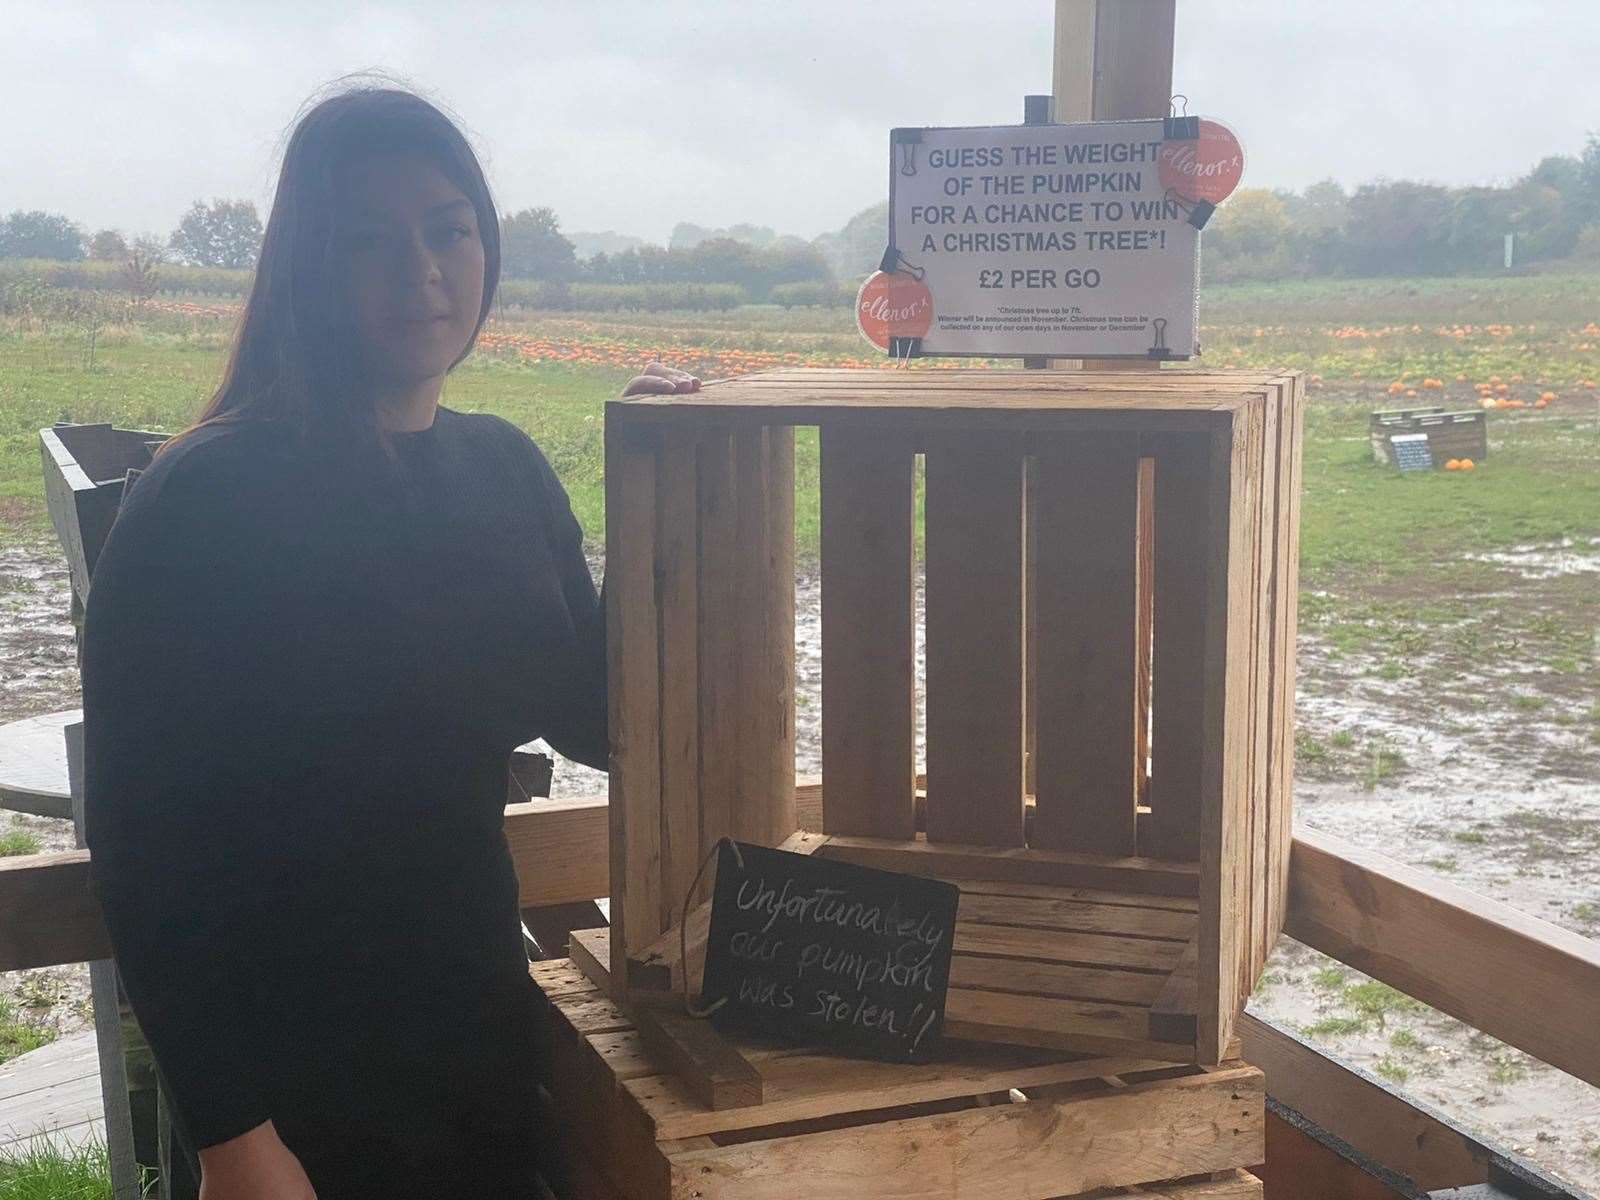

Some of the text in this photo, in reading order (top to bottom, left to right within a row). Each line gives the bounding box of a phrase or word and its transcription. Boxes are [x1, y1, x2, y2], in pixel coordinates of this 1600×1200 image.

[928, 142, 1162, 168] GUESS THE WEIGHT
[943, 171, 1141, 196] OF THE PUMPKIN
[911, 199, 1178, 225] FOR A CHANCE TO WIN
[921, 234, 937, 252] A
[943, 231, 1077, 252] CHRISTMAS
[979, 268, 1101, 289] £2 PER GO
[730, 931, 933, 992] our pumpkin
[738, 976, 936, 1054] was stolen!!
